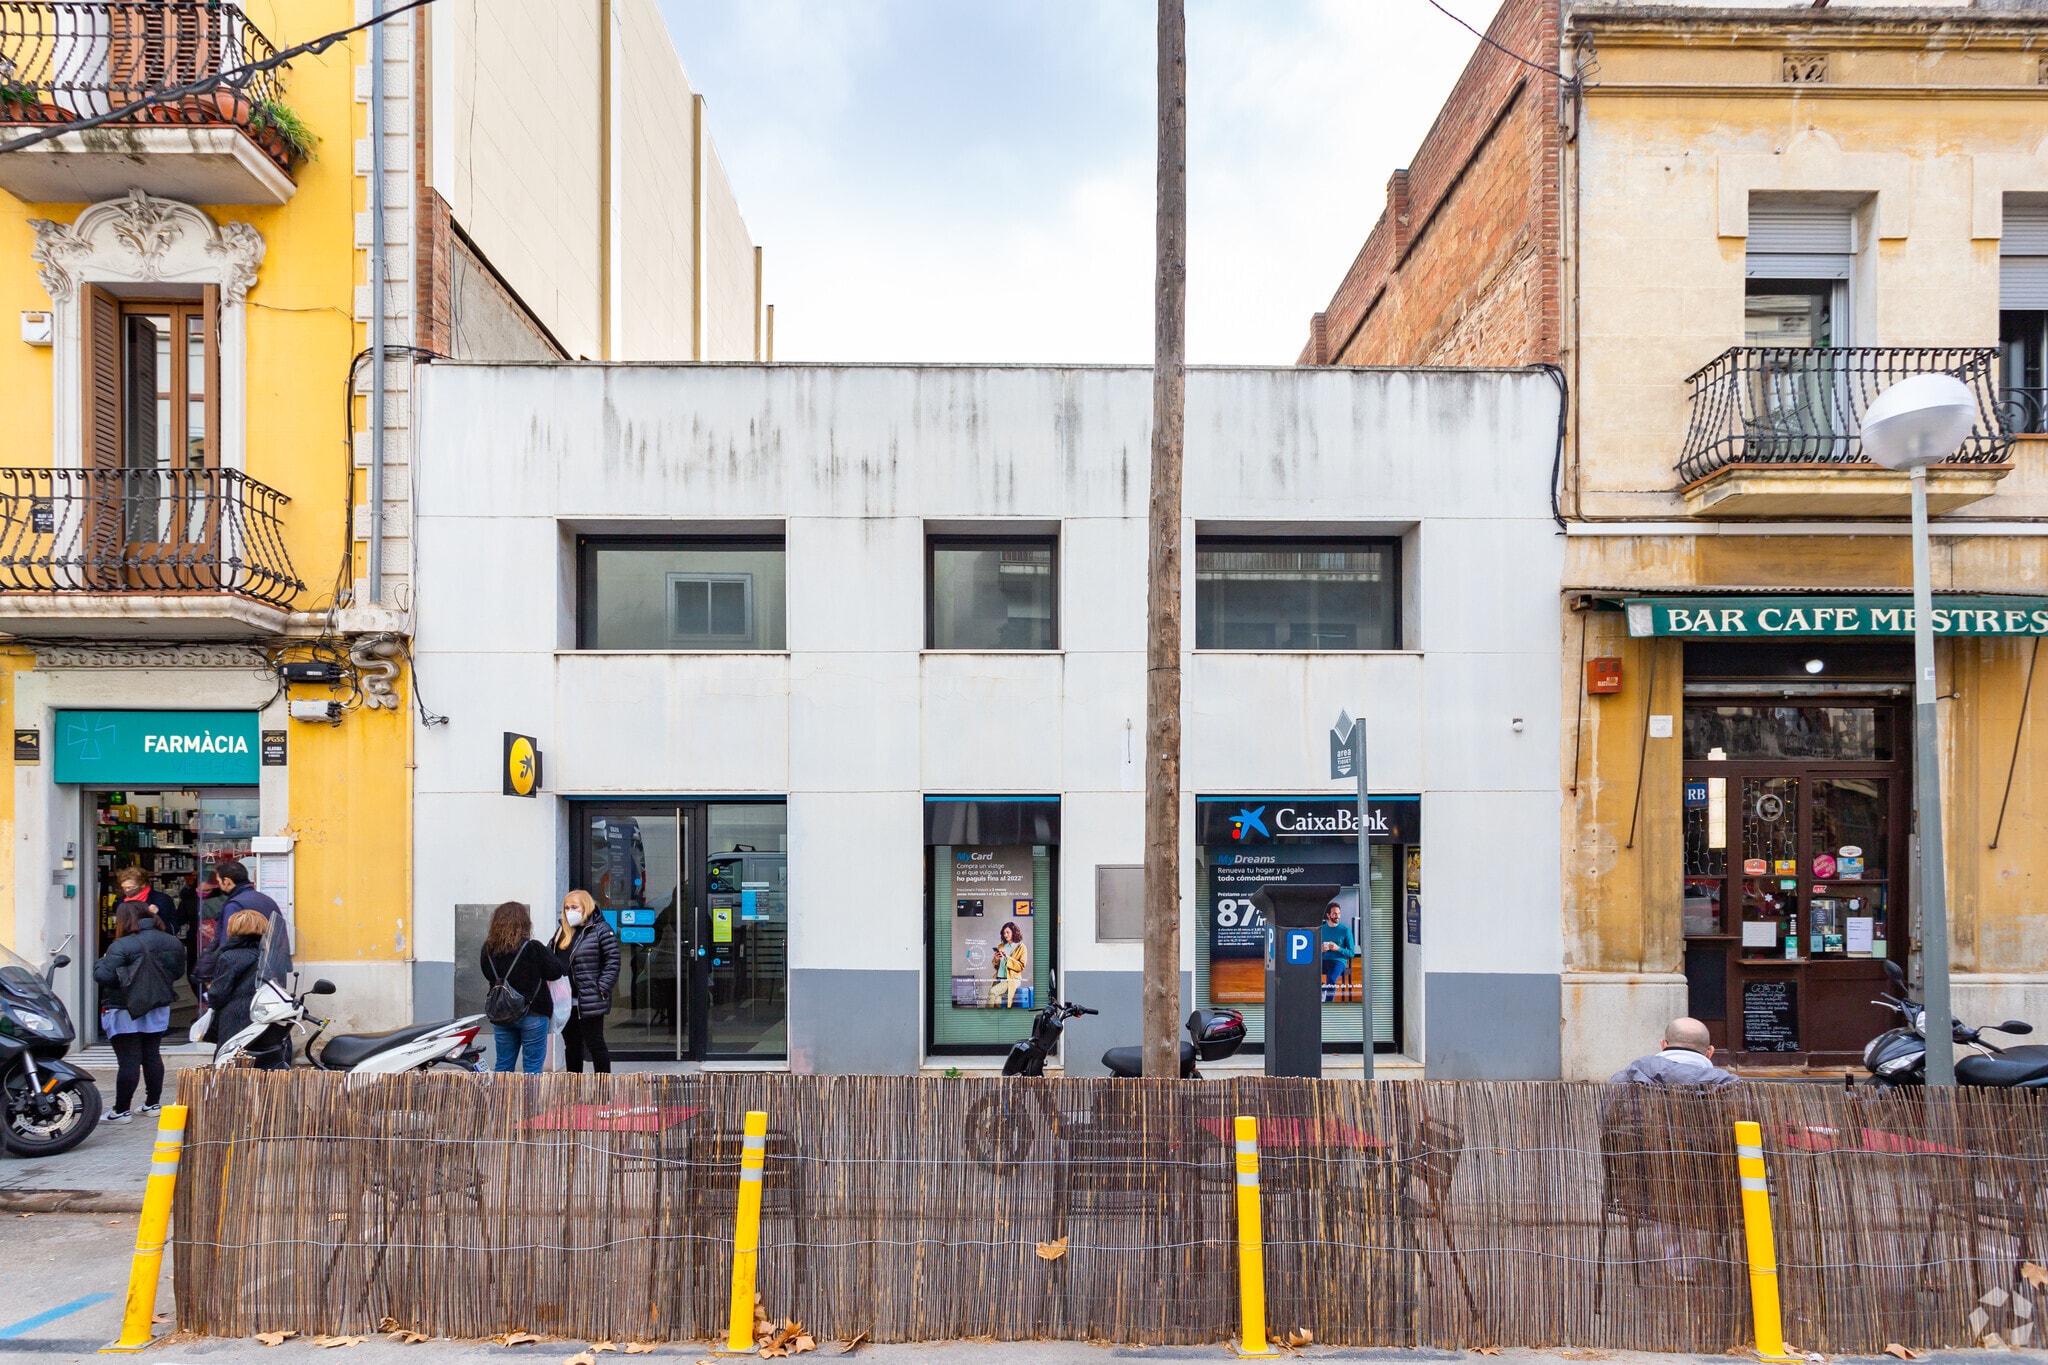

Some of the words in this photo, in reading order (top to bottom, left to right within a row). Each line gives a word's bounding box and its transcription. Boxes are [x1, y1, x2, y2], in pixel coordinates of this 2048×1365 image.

[1667, 609, 1748, 632] BAR
[1758, 608, 1858, 632] CAFE
[144, 730, 248, 753] FARMÀCIA
[1337, 749, 1351, 757] area
[1688, 789, 1706, 800] RB
[956, 852, 993, 862] MyCard
[1217, 854, 1276, 866] MyDreams
[1255, 867, 1275, 876] hogar
[1282, 866, 1305, 876] págalo
[1268, 928, 1274, 954] P
[1291, 934, 1308, 960] P
